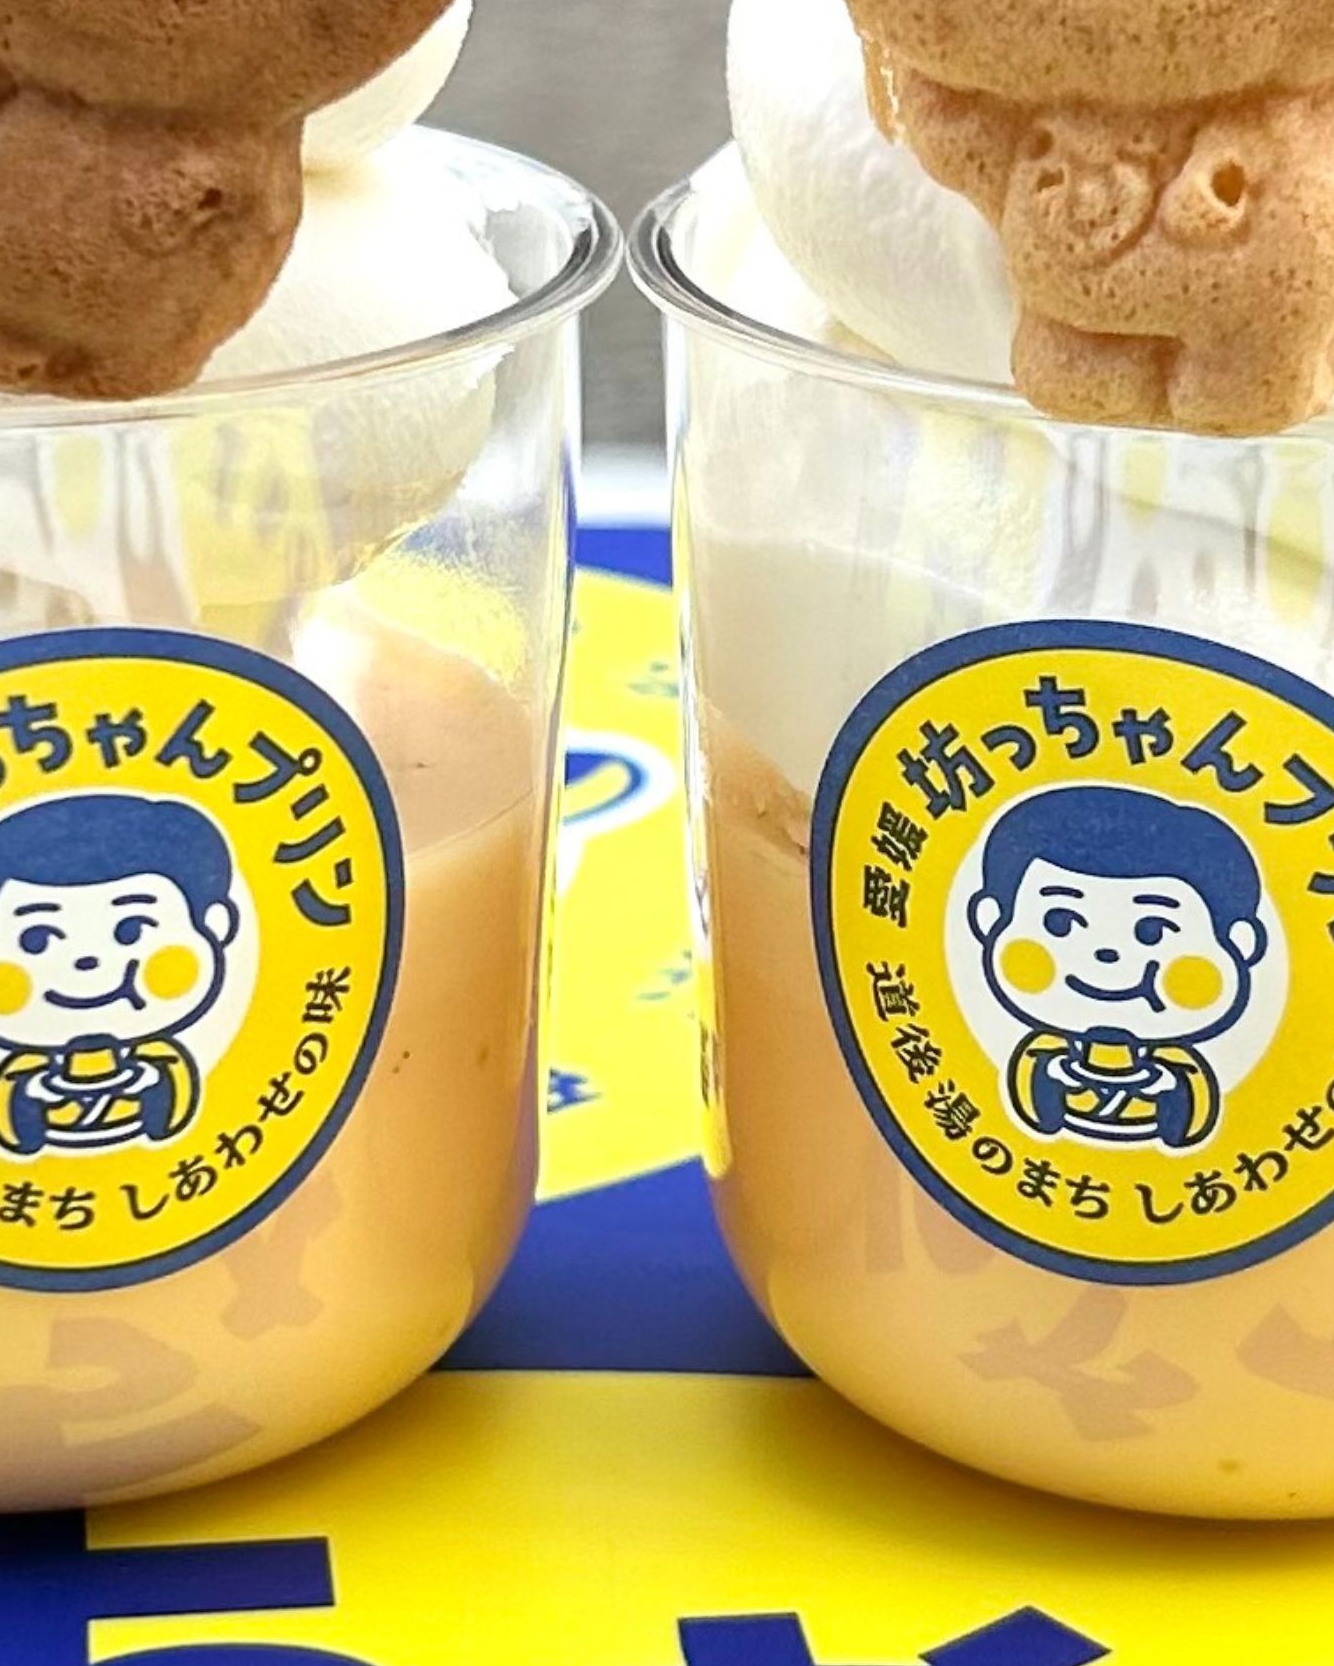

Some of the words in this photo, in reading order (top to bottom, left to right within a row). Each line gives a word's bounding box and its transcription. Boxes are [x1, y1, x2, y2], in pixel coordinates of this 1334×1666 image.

[864, 803, 927, 927] 愛媛
[123, 968, 349, 1221] しあわせの味
[867, 962, 1109, 1222] 道後湯のまち
